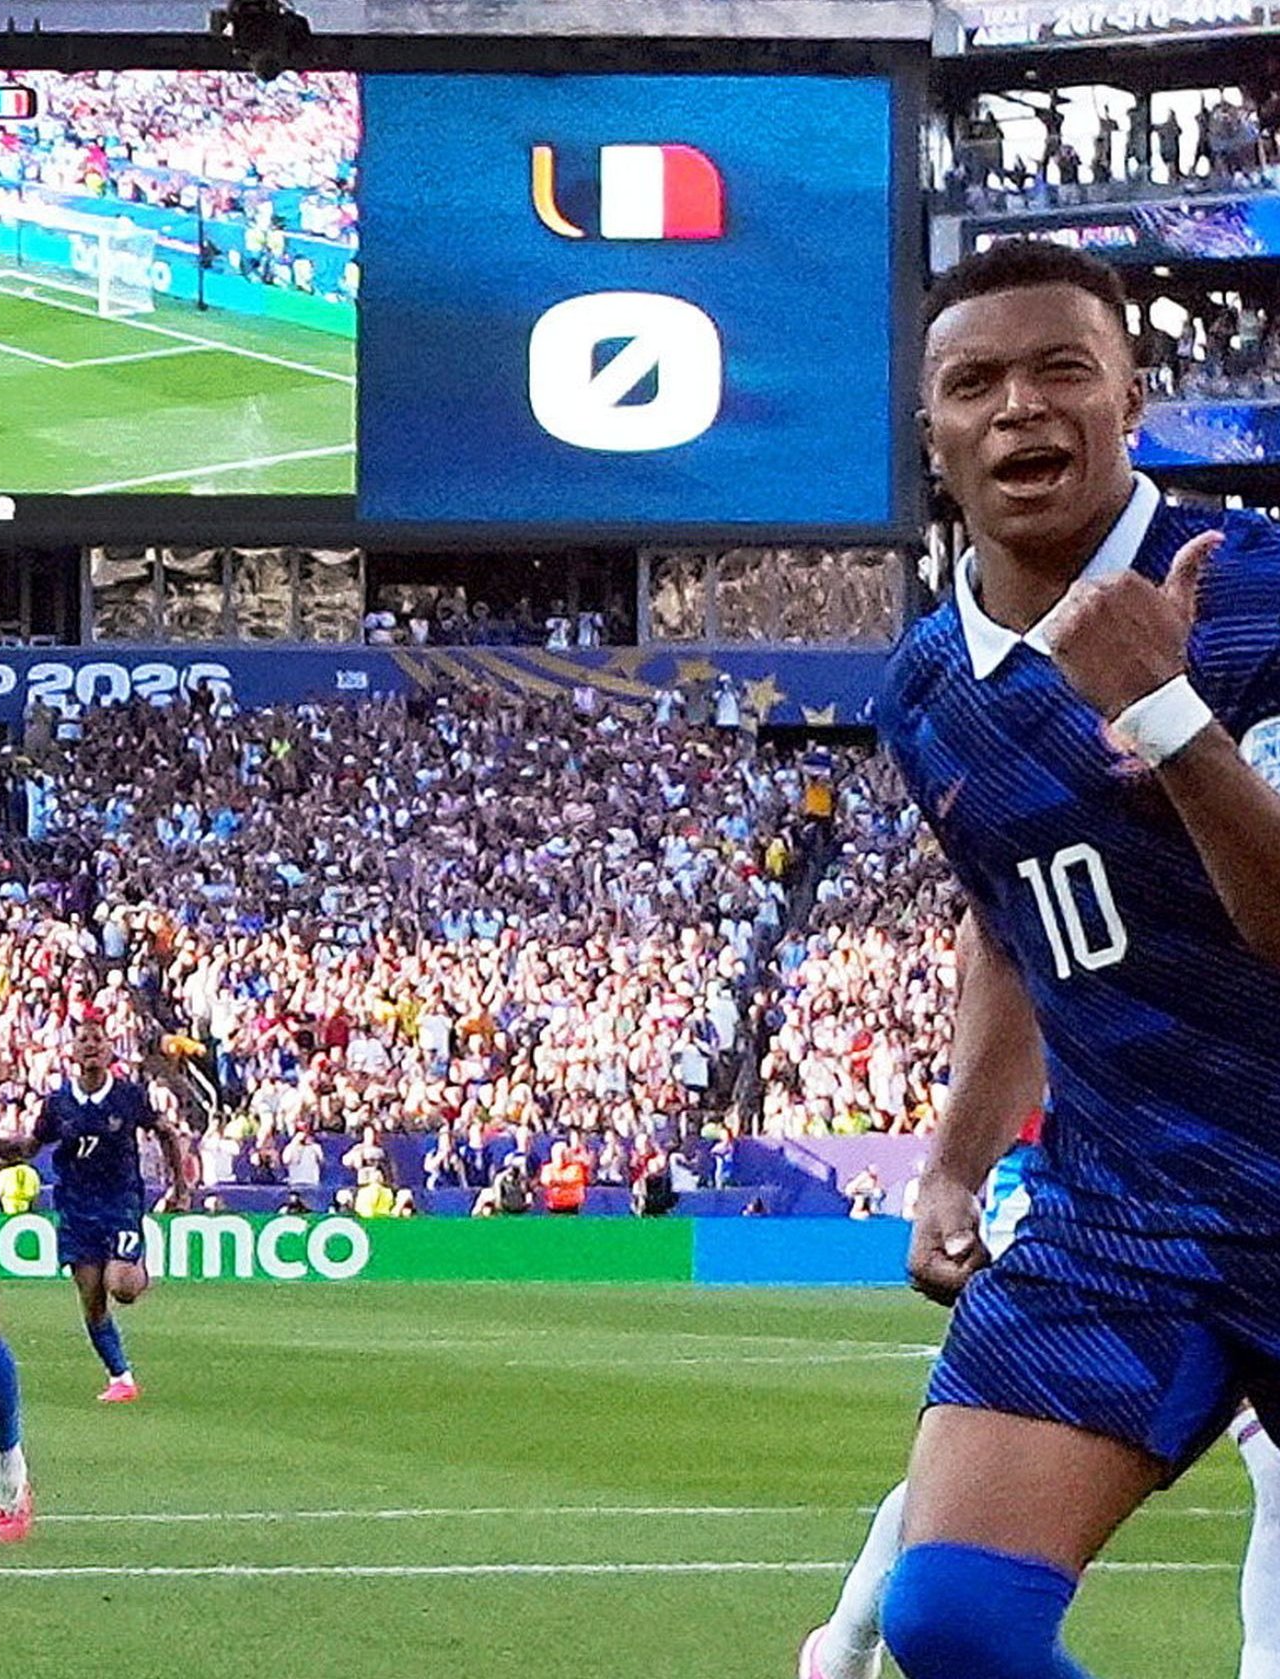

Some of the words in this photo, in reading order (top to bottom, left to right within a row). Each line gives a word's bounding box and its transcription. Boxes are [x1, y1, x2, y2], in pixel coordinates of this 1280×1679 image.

[528, 290, 722, 452] 0
[26, 662, 236, 711] 2026
[1017, 842, 1128, 980] 10
[77, 1136, 100, 1160] 17
[116, 1230, 140, 1256] 17
